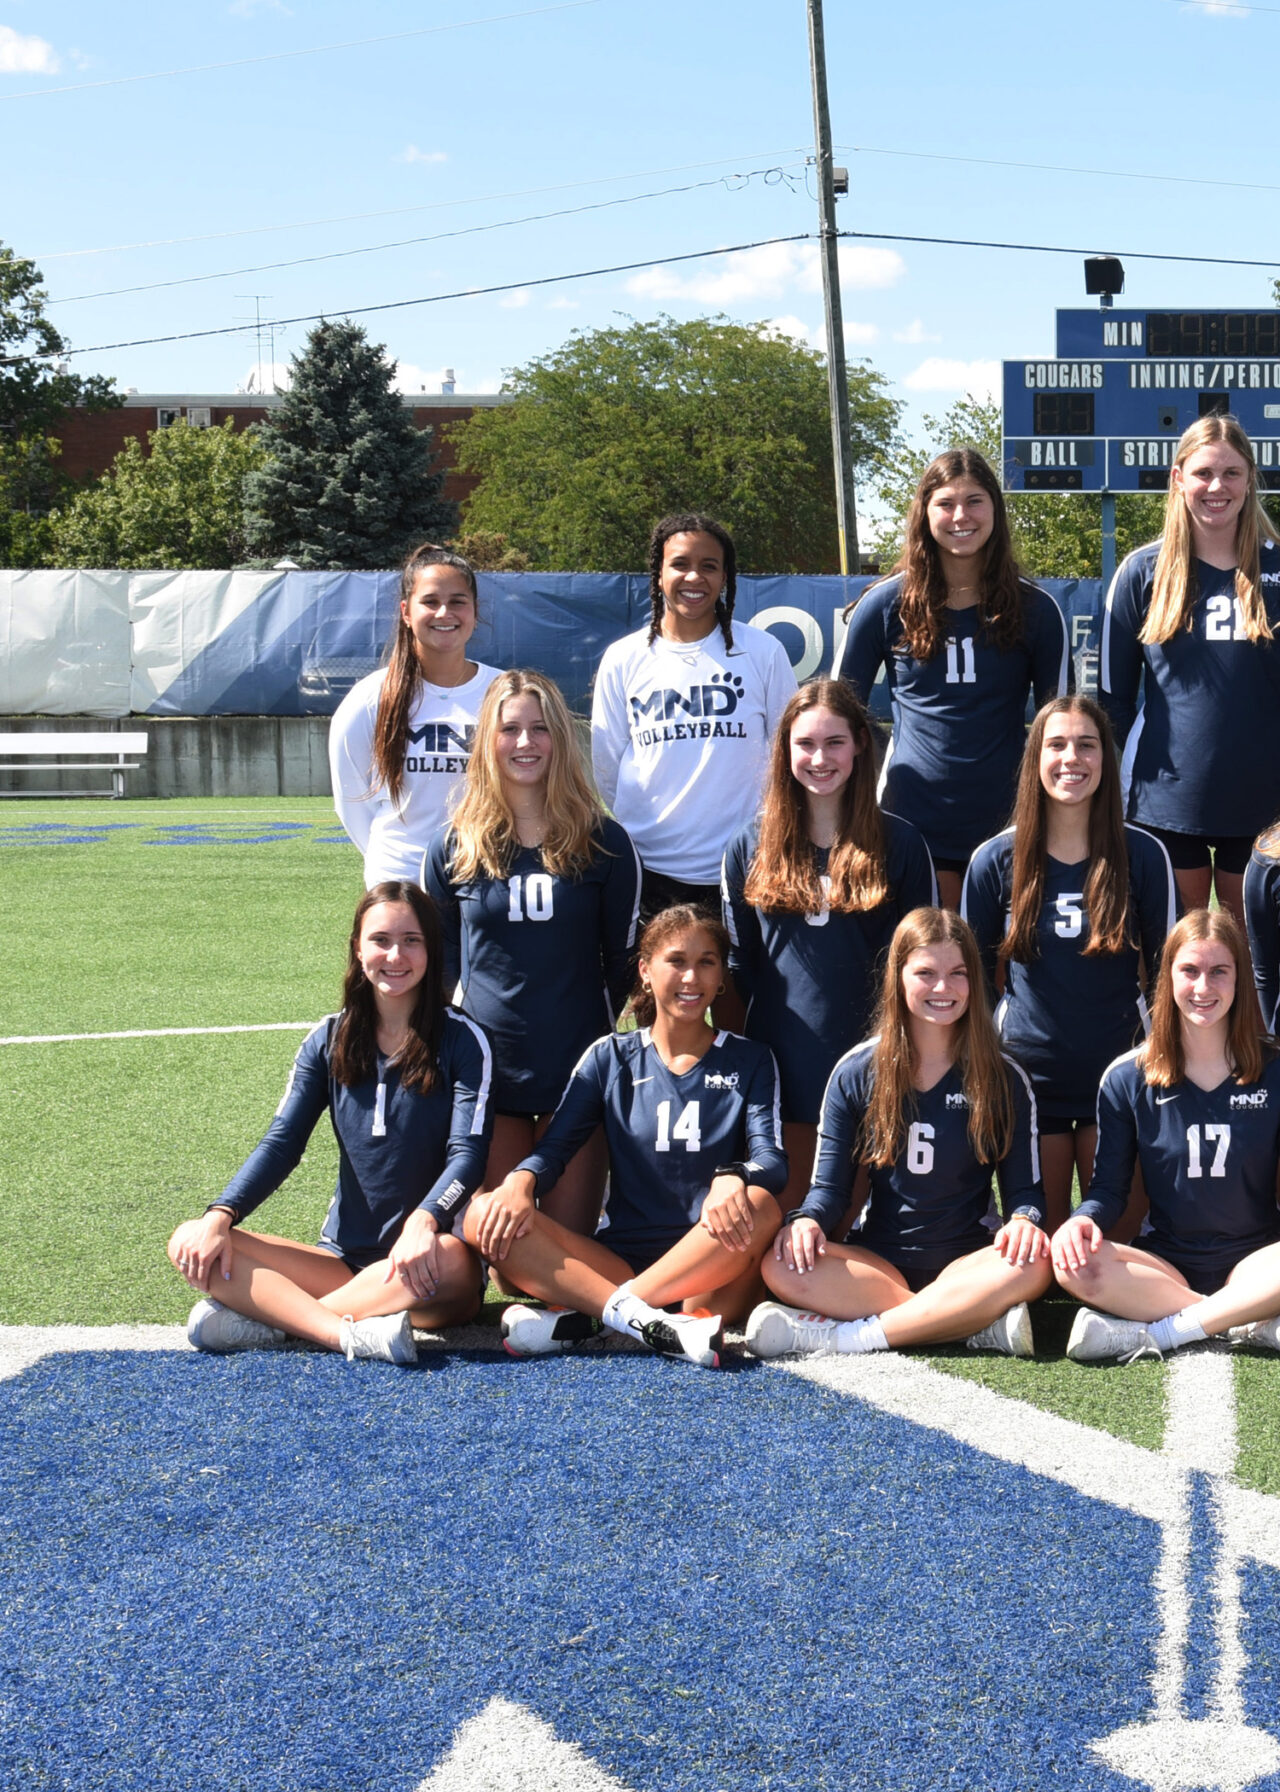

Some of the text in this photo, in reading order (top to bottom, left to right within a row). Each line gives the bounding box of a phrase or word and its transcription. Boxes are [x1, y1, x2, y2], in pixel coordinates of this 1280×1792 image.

[1103, 322, 1143, 346] MIN
[1024, 364, 1103, 388] COUGARS
[1030, 442, 1077, 466] BALL
[1206, 595, 1247, 640] 21
[945, 636, 976, 683] 11
[630, 685, 737, 727] MND
[407, 724, 474, 753] MN
[637, 722, 747, 746] VOLLEYBALL
[508, 873, 553, 922] 10
[1054, 893, 1083, 938] 5
[704, 1074, 738, 1086] MND
[372, 1083, 387, 1136] 1
[946, 1094, 968, 1104] MN
[1230, 1093, 1267, 1104] MND
[1230, 1103, 1268, 1111] COUGARS
[655, 1100, 701, 1152] 14
[907, 1122, 936, 1174] 6
[1187, 1124, 1232, 1178] 17
